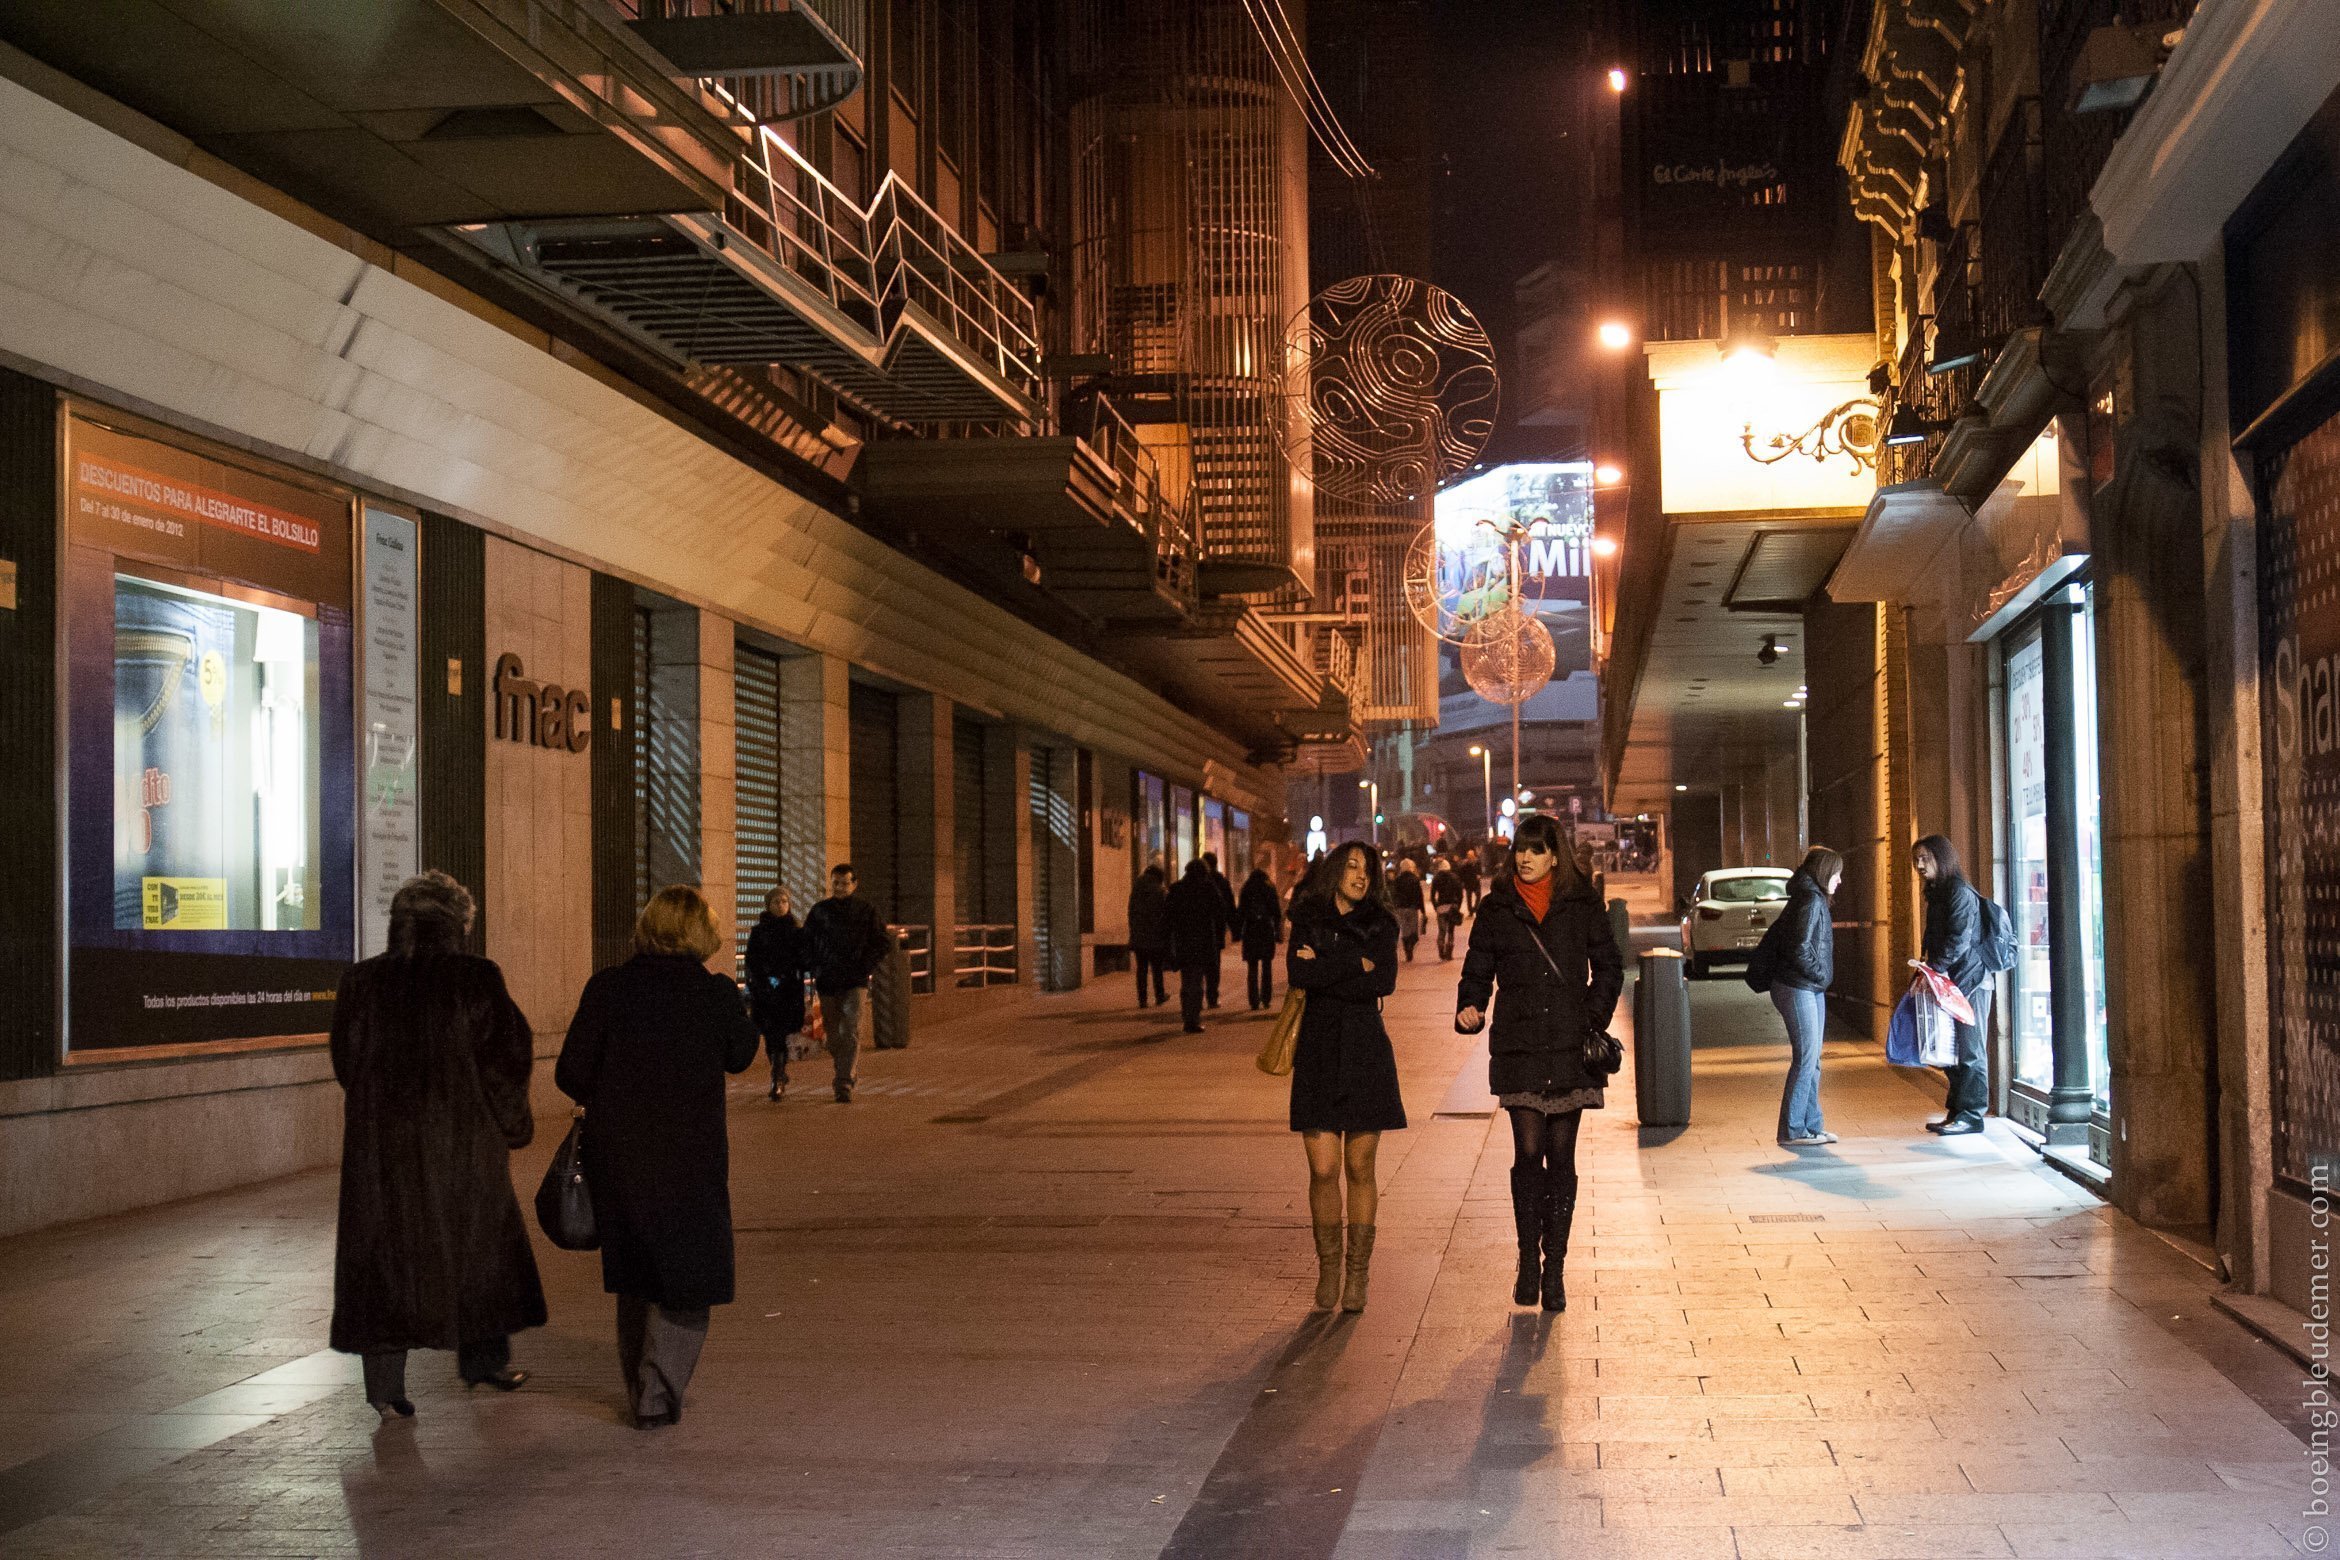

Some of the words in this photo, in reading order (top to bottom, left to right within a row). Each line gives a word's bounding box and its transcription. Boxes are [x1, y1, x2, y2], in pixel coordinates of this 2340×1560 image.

[80, 462, 161, 503] DESCUENTOS
[163, 486, 193, 512] PARA
[195, 496, 256, 530] ALEGRARTE
[258, 513, 271, 534] EL
[272, 517, 318, 547] BOLSILLO
[80, 498, 94, 513] Del
[95, 501, 101, 514] 7
[102, 503, 110, 517] al
[111, 506, 121, 520] 30
[121, 508, 131, 523] de
[132, 514, 154, 529] enero
[155, 516, 165, 531] de
[166, 519, 184, 537] 2012
[493, 652, 590, 754] fnac
[143, 995, 164, 1009] Todos
[165, 995, 175, 1008] los
[176, 994, 209, 1010] productos
[210, 992, 246, 1008] disponibles
[247, 991, 256, 1004] las
[257, 991, 265, 1003] 24
[265, 991, 283, 1003] horas
[283, 990, 293, 1002] del
[303, 992, 311, 1001] en
